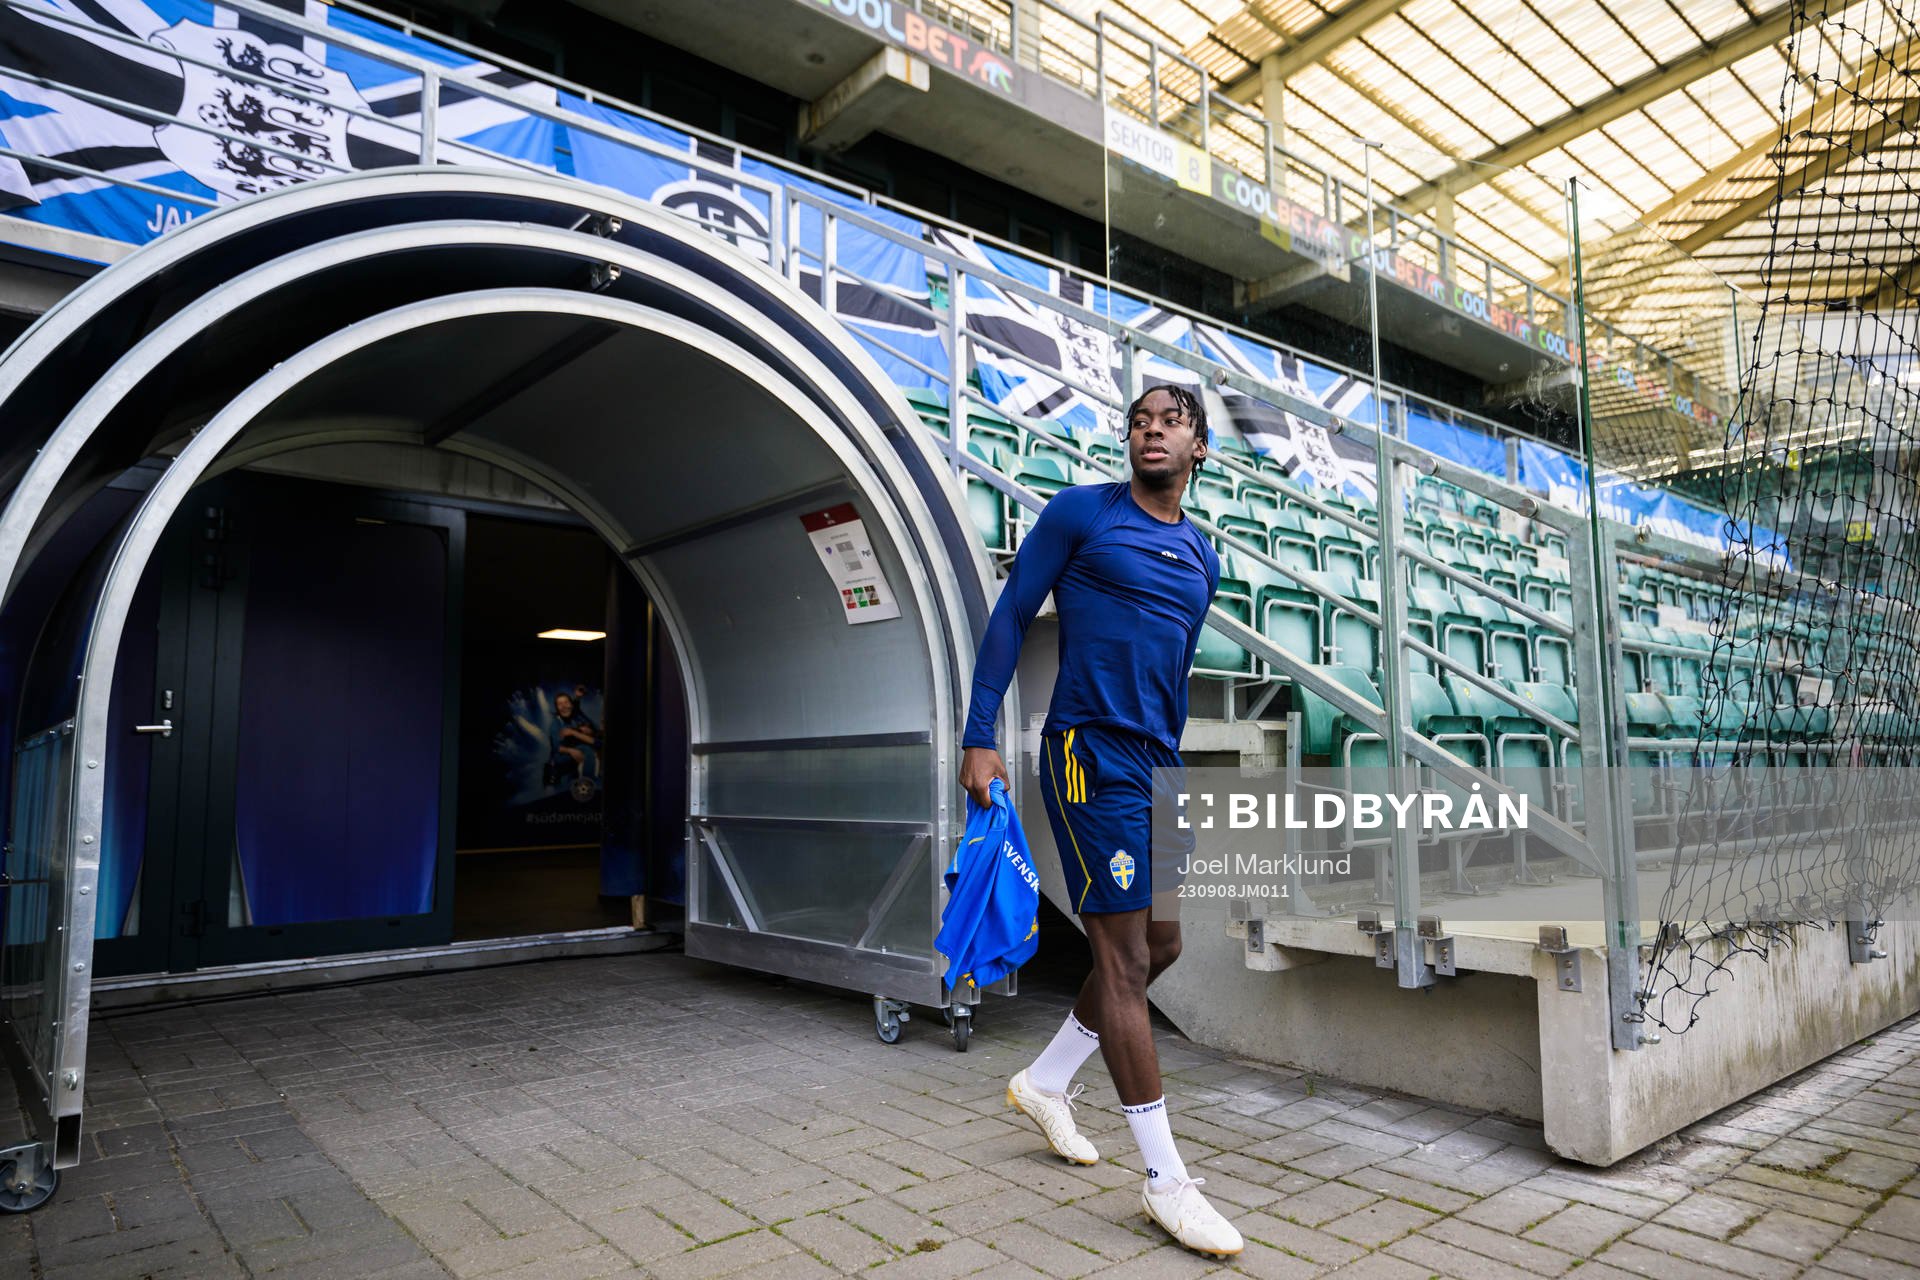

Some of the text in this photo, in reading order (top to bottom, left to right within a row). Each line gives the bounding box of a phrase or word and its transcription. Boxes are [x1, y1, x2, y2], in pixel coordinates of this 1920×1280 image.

[1110, 120, 1201, 182] SEKTOR 8
[1221, 172, 1315, 237] COOLBET
[1453, 287, 1515, 334] COOLBET
[1003, 840, 1040, 894] SVENSK
